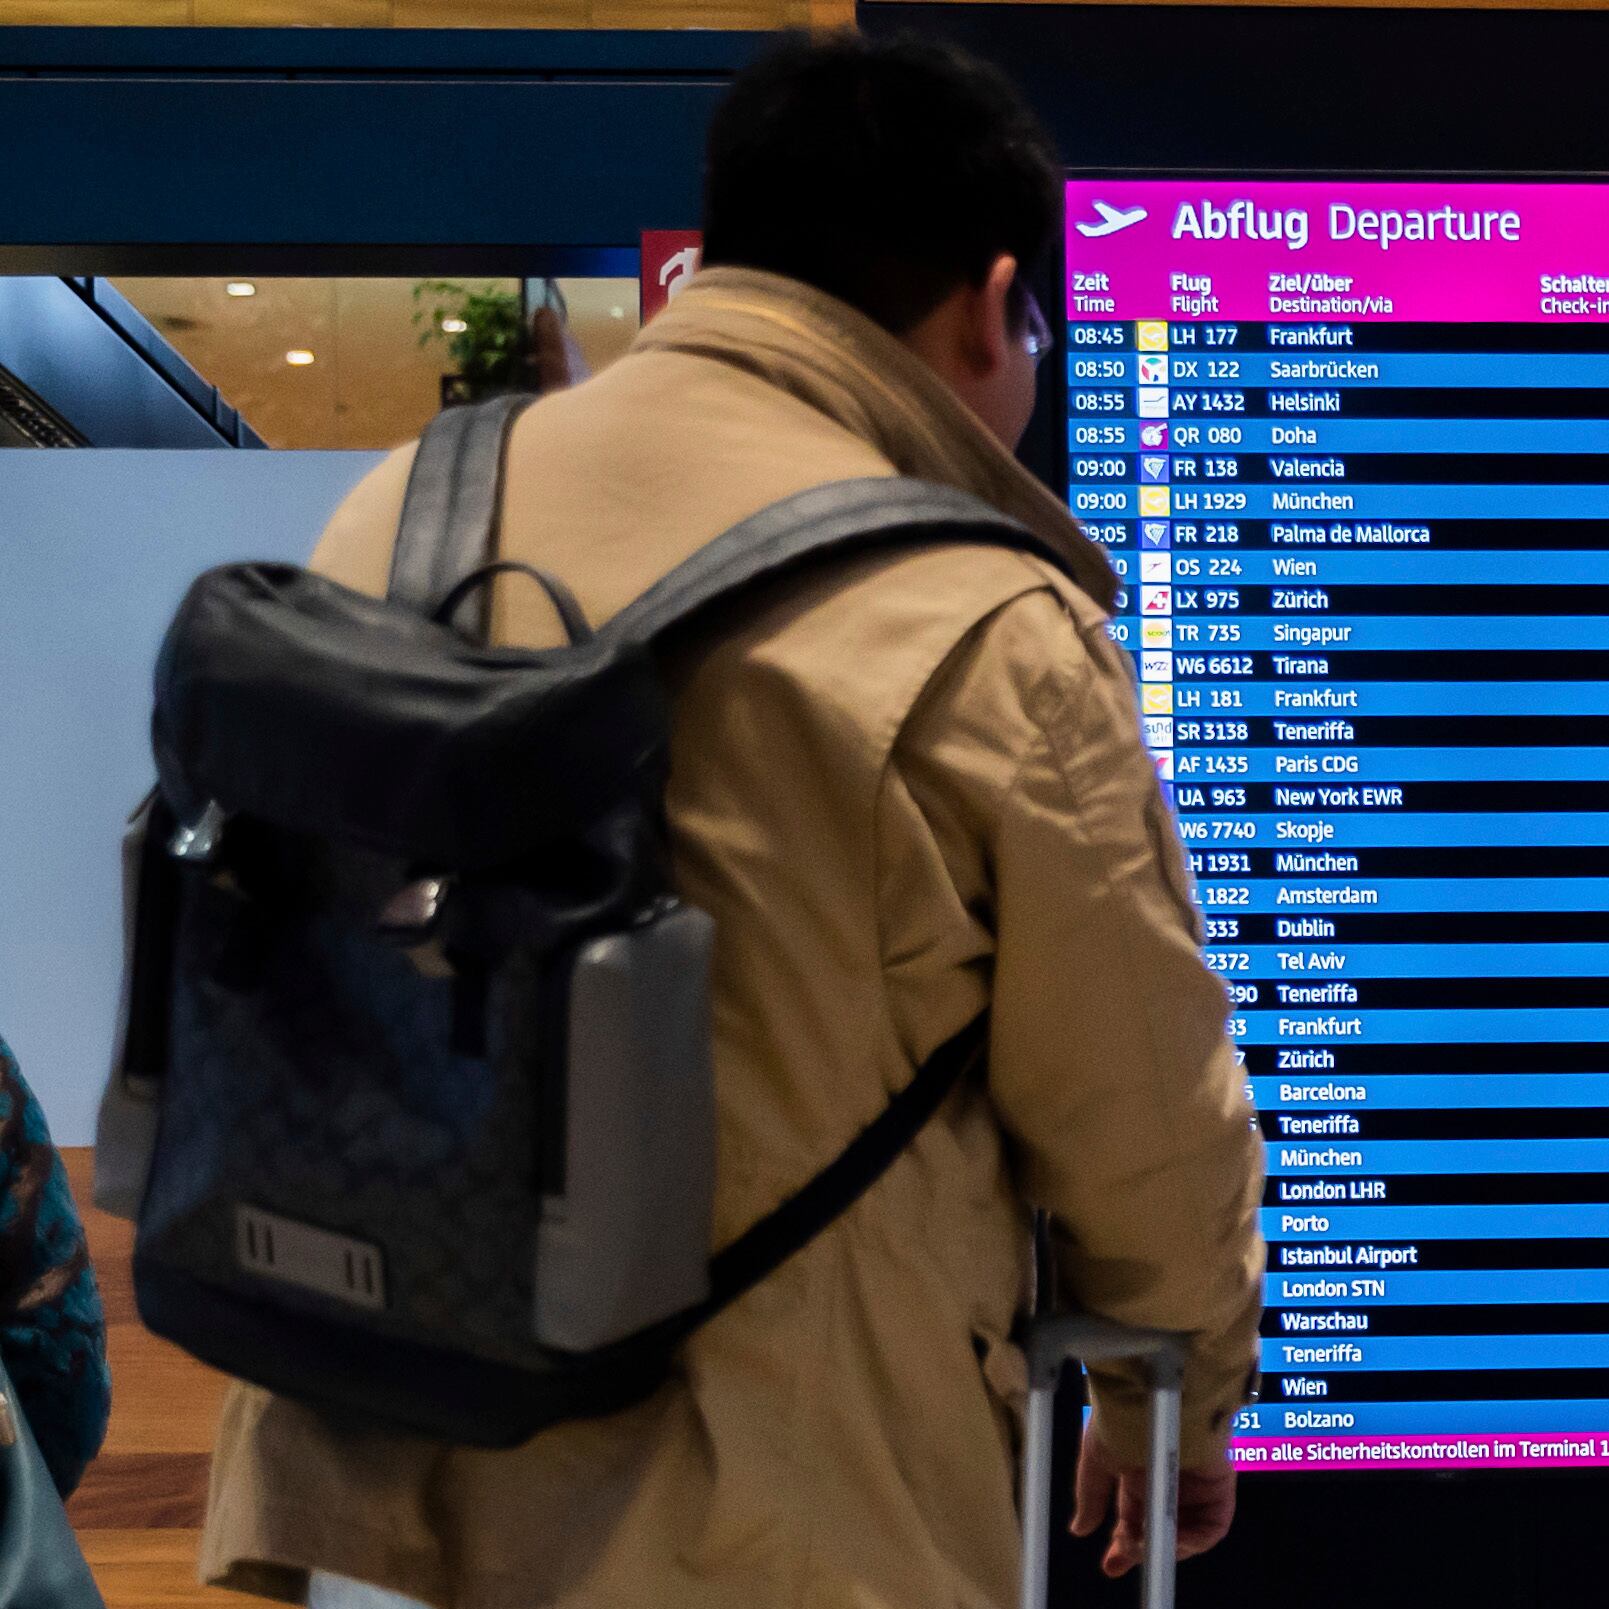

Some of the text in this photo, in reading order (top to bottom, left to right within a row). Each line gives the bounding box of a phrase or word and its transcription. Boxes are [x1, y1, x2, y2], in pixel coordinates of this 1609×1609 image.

[1172, 202, 1309, 250] Abflug
[1330, 204, 1521, 250] Departure
[1073, 273, 1109, 290] Zeit
[1171, 273, 1211, 296] Flug
[1269, 274, 1353, 295] Ziel/über
[1073, 294, 1115, 313] Time
[1172, 294, 1219, 318] Flight
[1269, 295, 1393, 315] Destination/via
[1074, 327, 1124, 345] 08:45
[1173, 328, 1196, 345] LH
[1206, 328, 1238, 345] 177
[1270, 326, 1353, 346] Frankfurt
[1075, 360, 1125, 378] 08:50
[1173, 361, 1198, 378] DX
[1207, 361, 1240, 378] 122
[1270, 360, 1379, 379] Saarbrücken
[1075, 393, 1125, 411] 08:55
[1172, 394, 1198, 411] AY
[1202, 394, 1245, 411] 1432
[1271, 393, 1340, 411] Helsinki
[1076, 426, 1126, 444] 08:55
[1174, 427, 1200, 447] QR
[1208, 427, 1242, 444] 080
[1271, 426, 1317, 444] Doha
[1175, 526, 1197, 543] FR
[1205, 525, 1239, 543] 218
[1273, 524, 1326, 543] Palma
[1330, 524, 1352, 543] de
[1356, 525, 1430, 543] Mallorca
[1281, 1246, 1353, 1266] Istanbul
[1356, 1245, 1418, 1269] Airport
[1270, 1443, 1303, 1462] alle
[1306, 1440, 1490, 1462] Sicherheitskontrollen
[1493, 1440, 1516, 1458] im
[1519, 1439, 1596, 1458] Terminal
